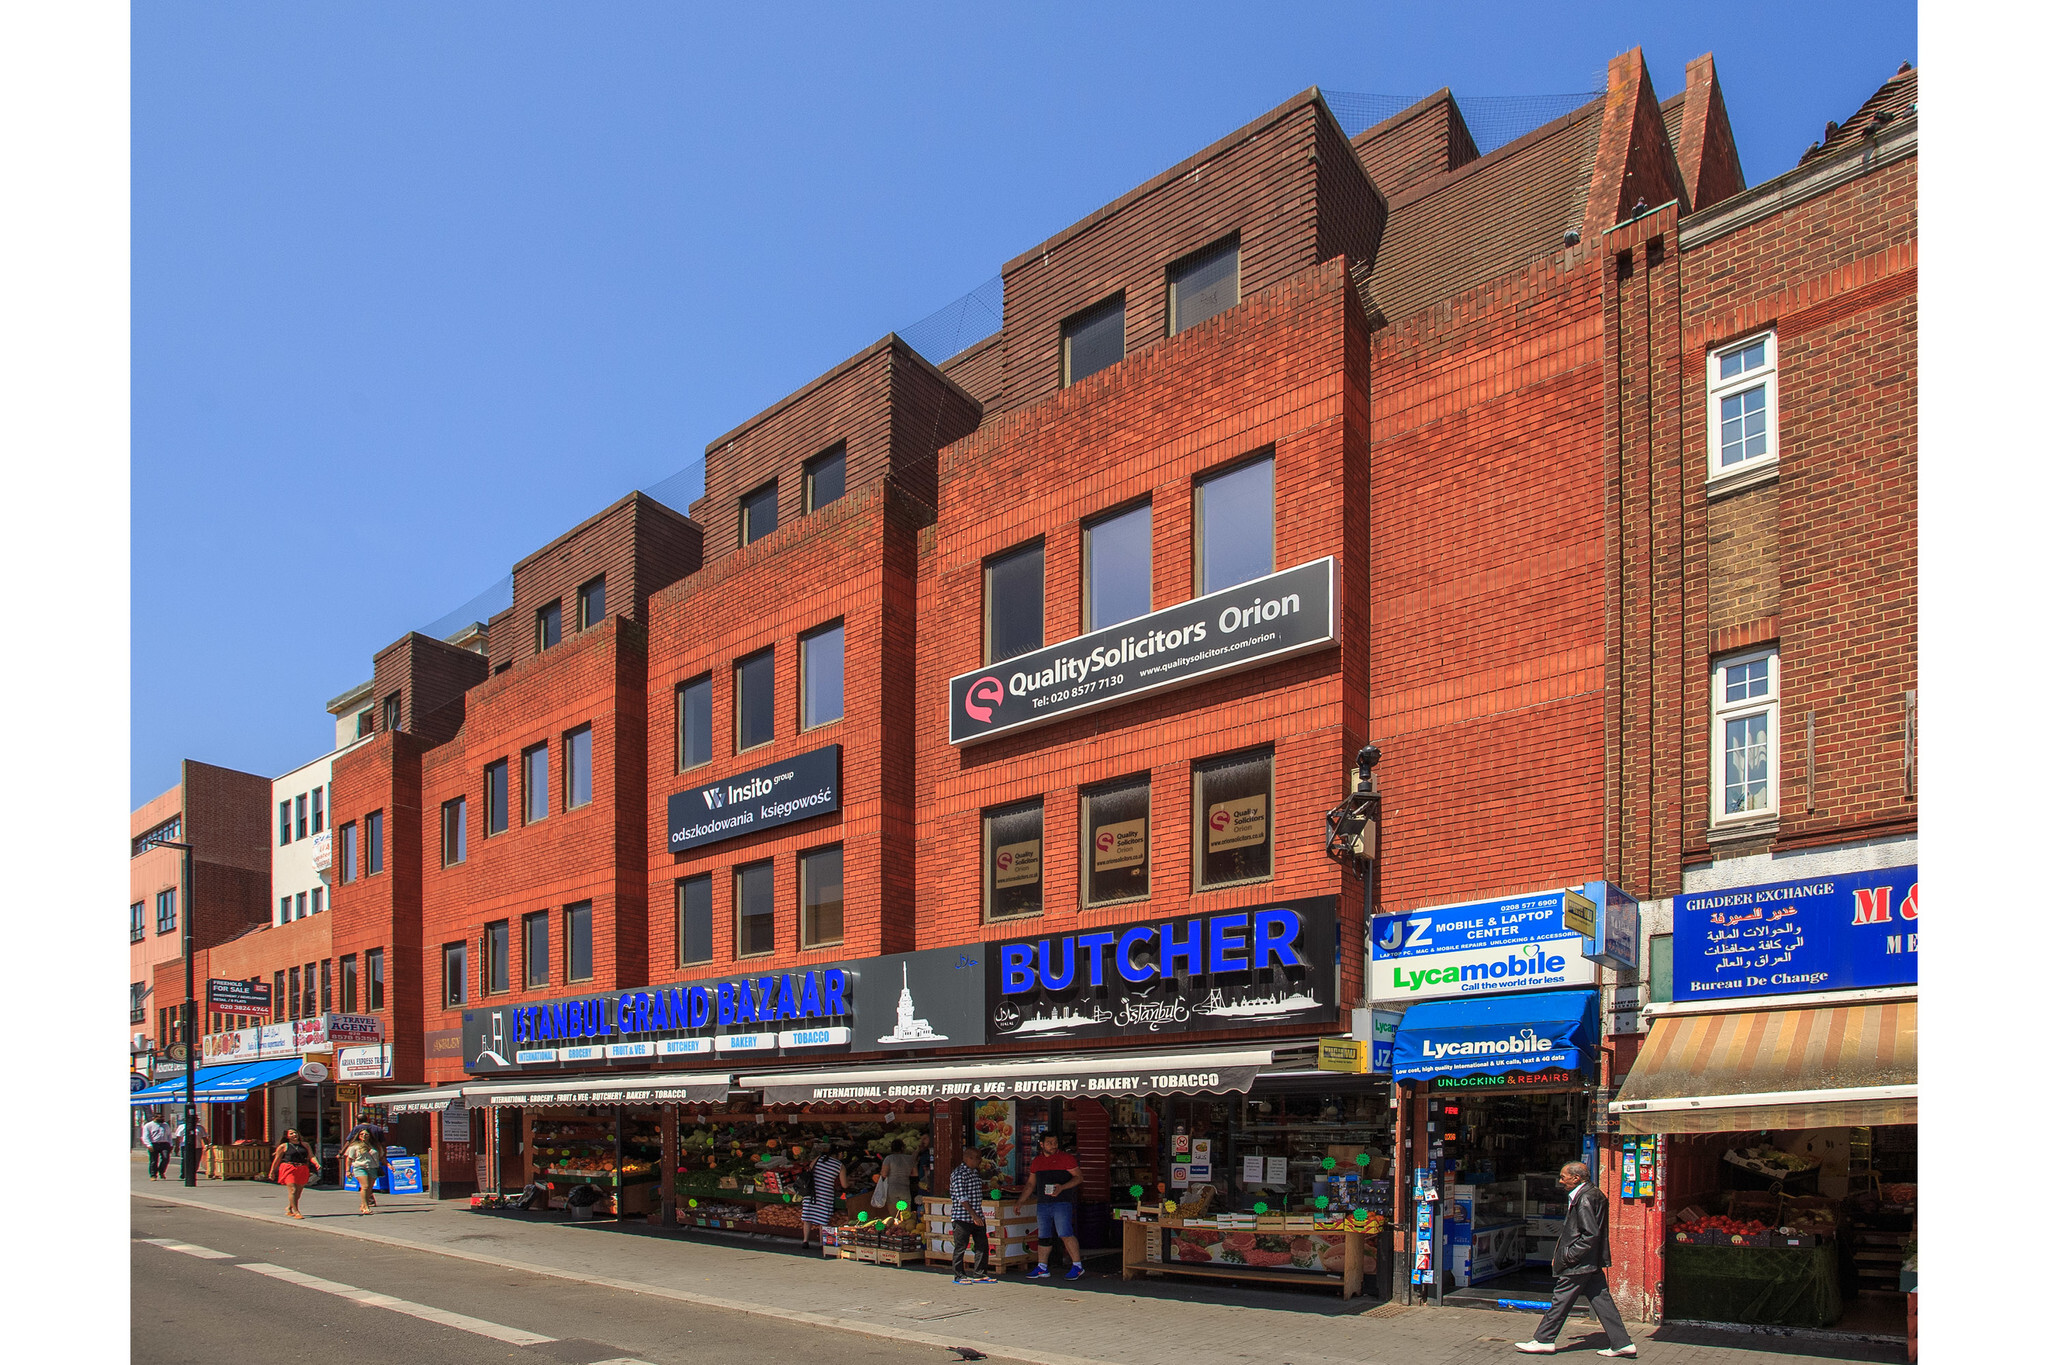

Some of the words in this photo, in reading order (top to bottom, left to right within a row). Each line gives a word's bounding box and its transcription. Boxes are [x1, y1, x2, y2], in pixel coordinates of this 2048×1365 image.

[1009, 621, 1207, 696] QualitySolicitors
[1218, 593, 1300, 634] Orion
[1139, 632, 1276, 677] www.qualitysolicitors.com/orion
[1032, 695, 1049, 708] Tel:
[1051, 690, 1069, 703] 020
[1071, 682, 1096, 698] 8577
[1098, 674, 1124, 690] 7130
[728, 776, 773, 805] Insito
[773, 771, 795, 785] group
[671, 810, 754, 843] odszkodowania
[760, 786, 832, 819] księgowość
[1234, 808, 1258, 817] Quality
[1234, 815, 1264, 825] Solicitors
[1117, 831, 1138, 839] Quality
[1117, 837, 1143, 846] Solicitors
[1015, 851, 1033, 859] Quality
[1686, 893, 1753, 911] GHADEER
[1756, 882, 1835, 903] EXCHANGE
[1500, 903, 1520, 911] 0208
[1852, 886, 1893, 925] M
[1436, 918, 1484, 933] MOBILE
[1488, 917, 1497, 926] &
[1501, 910, 1554, 924] LAPTOP
[1380, 917, 1432, 950] JZ
[1467, 925, 1519, 940] CENTER
[1490, 936, 1528, 946] UNLOCKING
[1758, 939, 1782, 951] كافة
[1001, 908, 1301, 996] BUTCHER
[1704, 943, 1755, 956] محافظات
[1393, 947, 1566, 990] Lycamobile
[1461, 983, 1479, 991] Call
[1481, 982, 1498, 990] the
[1499, 978, 1526, 987] world
[1528, 977, 1543, 985] for
[1544, 976, 1565, 984] less
[1690, 978, 1742, 992] Bureau
[1746, 976, 1767, 987] De
[1771, 972, 1829, 985] Change
[230, 986, 250, 994] SALE
[513, 998, 611, 1044] ISTANBUL
[617, 985, 710, 1034] GRAND
[718, 968, 845, 1025] BAZAAR
[331, 1022, 376, 1032] AGENT
[343, 1016, 376, 1024] TRAVEL
[731, 1037, 757, 1048] BAKERY
[793, 1031, 829, 1045] TOBACCO
[1423, 1031, 1552, 1058] Lycamobile
[568, 1048, 592, 1059] GROCERY
[612, 1046, 628, 1056] FRUIT
[634, 1044, 645, 1054] VEG
[667, 1041, 699, 1052] BUTCHERY
[518, 1050, 553, 1062] INTERNATIONAL
[1434, 1064, 1453, 1072] quality
[813, 1086, 881, 1098] INTERNATIONAL
[888, 1084, 934, 1097] GROCERY
[941, 1083, 972, 1095] FRUIT
[973, 1083, 981, 1094] &
[983, 1082, 1005, 1093] VEG
[1014, 1079, 1079, 1093] BUTCHERY
[1088, 1076, 1140, 1090] BAKERY
[1150, 1073, 1219, 1089] TOBACCO
[1438, 1076, 1505, 1087] UNLOCKING
[1507, 1076, 1516, 1085] &
[1518, 1073, 1569, 1083] REPAIRS
[490, 1095, 527, 1104] INTERNATIONAL
[529, 1095, 554, 1103] GROCERY
[556, 1094, 572, 1102] FRUIT
[577, 1093, 589, 1101] VEG
[592, 1092, 623, 1101] BUTCHERY
[626, 1091, 651, 1100] BAKERY
[655, 1090, 686, 1099] TOBACCO
